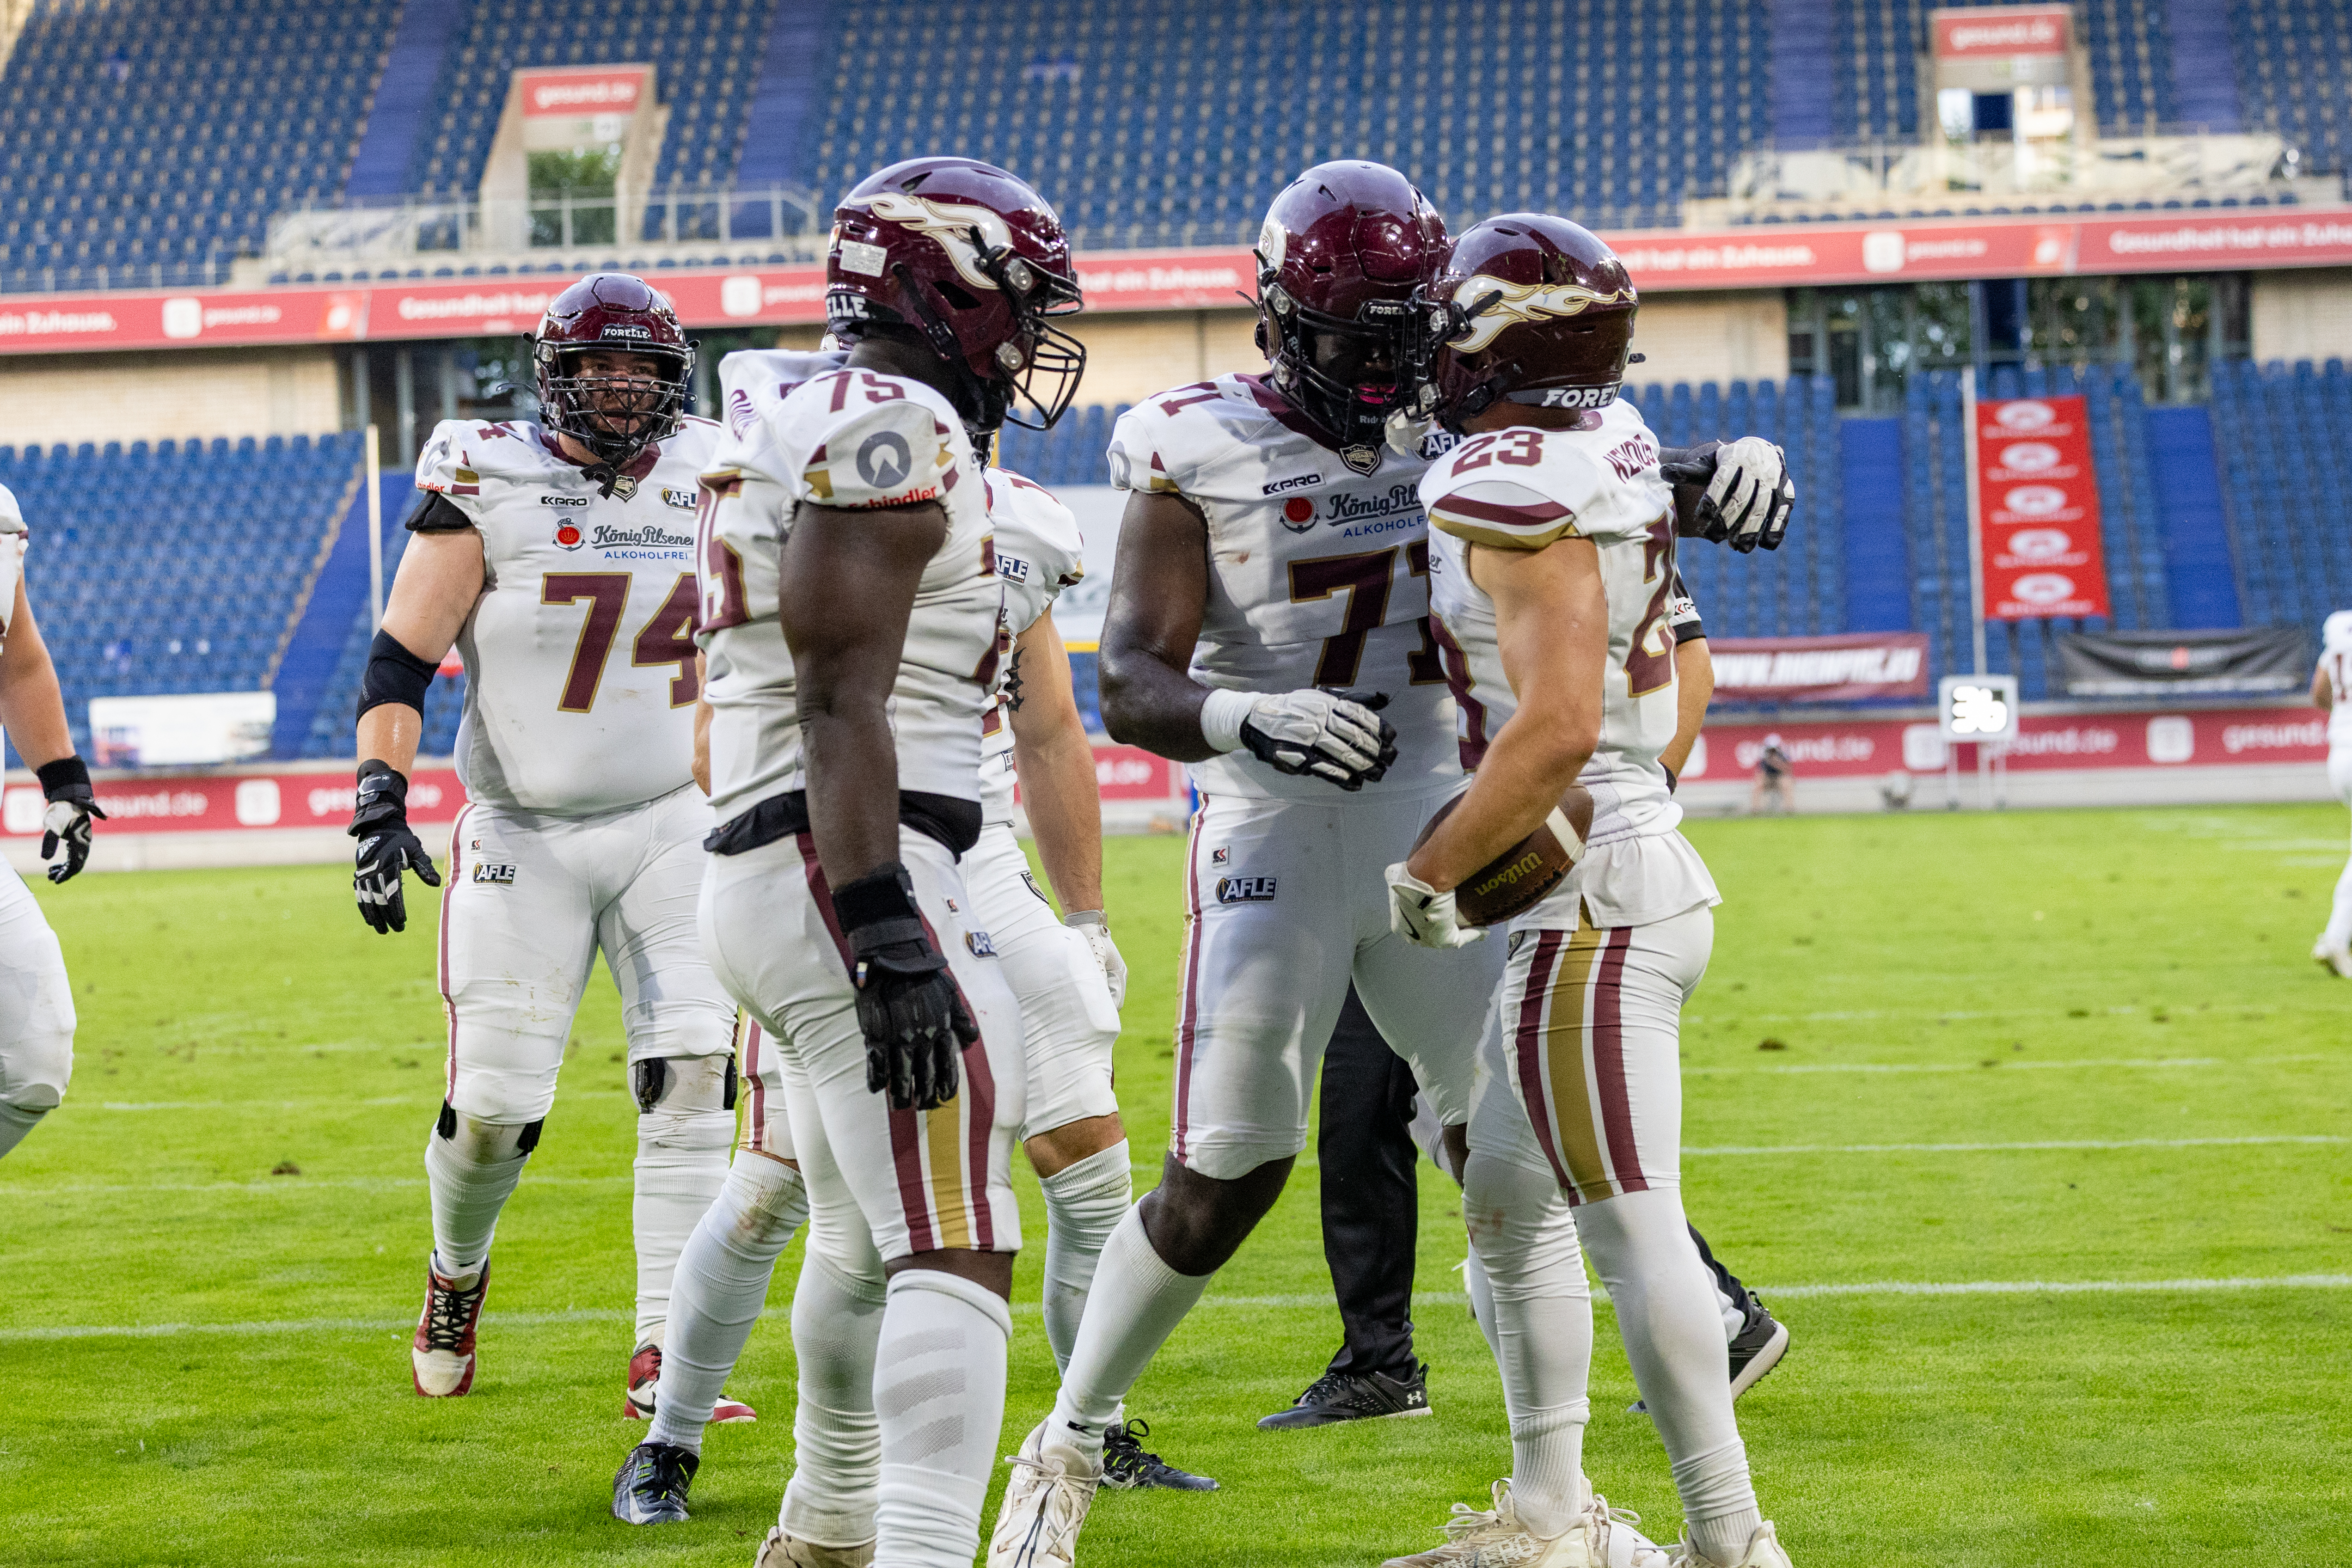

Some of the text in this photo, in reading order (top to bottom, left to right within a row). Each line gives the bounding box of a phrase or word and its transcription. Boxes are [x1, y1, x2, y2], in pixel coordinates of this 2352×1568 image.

[604, 328, 648, 338] FORELLE
[815, 371, 906, 413] 75
[1450, 431, 1544, 478] 23
[604, 551, 688, 560] ALKOHOLFREI
[1287, 539, 1446, 687] 71
[540, 572, 701, 714] 74
[476, 865, 515, 880] AFLE
[1223, 878, 1276, 900] AFLE
[1474, 851, 1544, 896] Wilson
